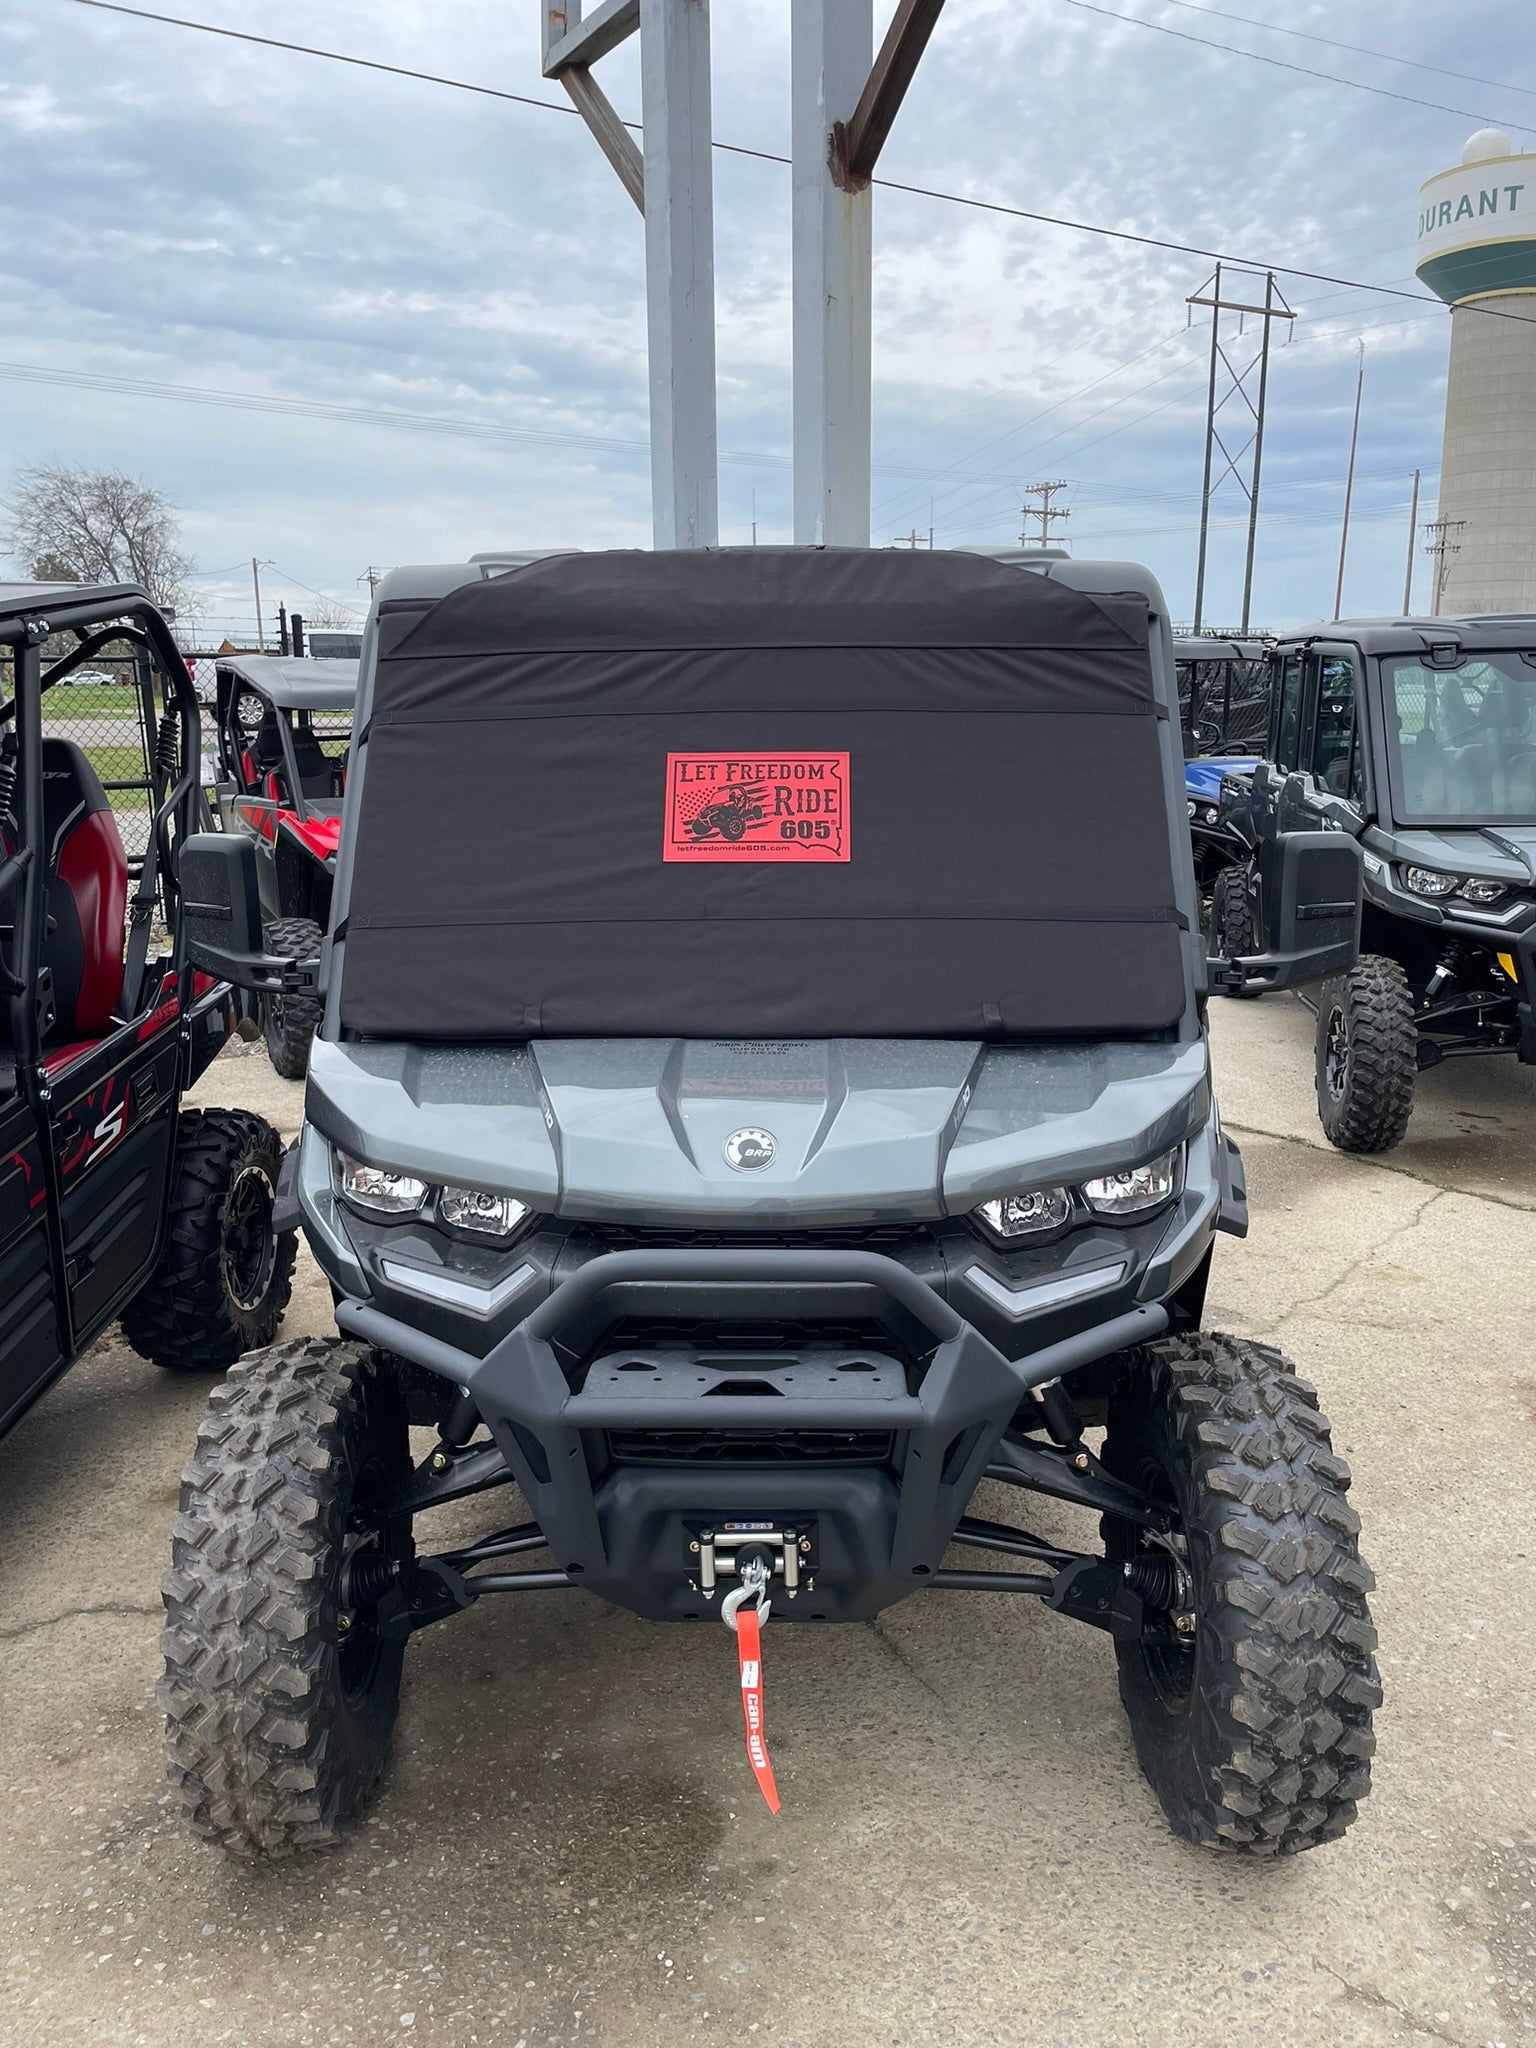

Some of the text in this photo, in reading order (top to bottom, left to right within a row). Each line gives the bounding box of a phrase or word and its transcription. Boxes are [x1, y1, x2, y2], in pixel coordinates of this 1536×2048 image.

[1418, 184, 1525, 239] DURANT
[680, 763, 825, 783] LET FREEDOM
[773, 786, 838, 816] RIDE
[744, 1148, 772, 1157] BRP
[747, 1693, 766, 1768] can-am
